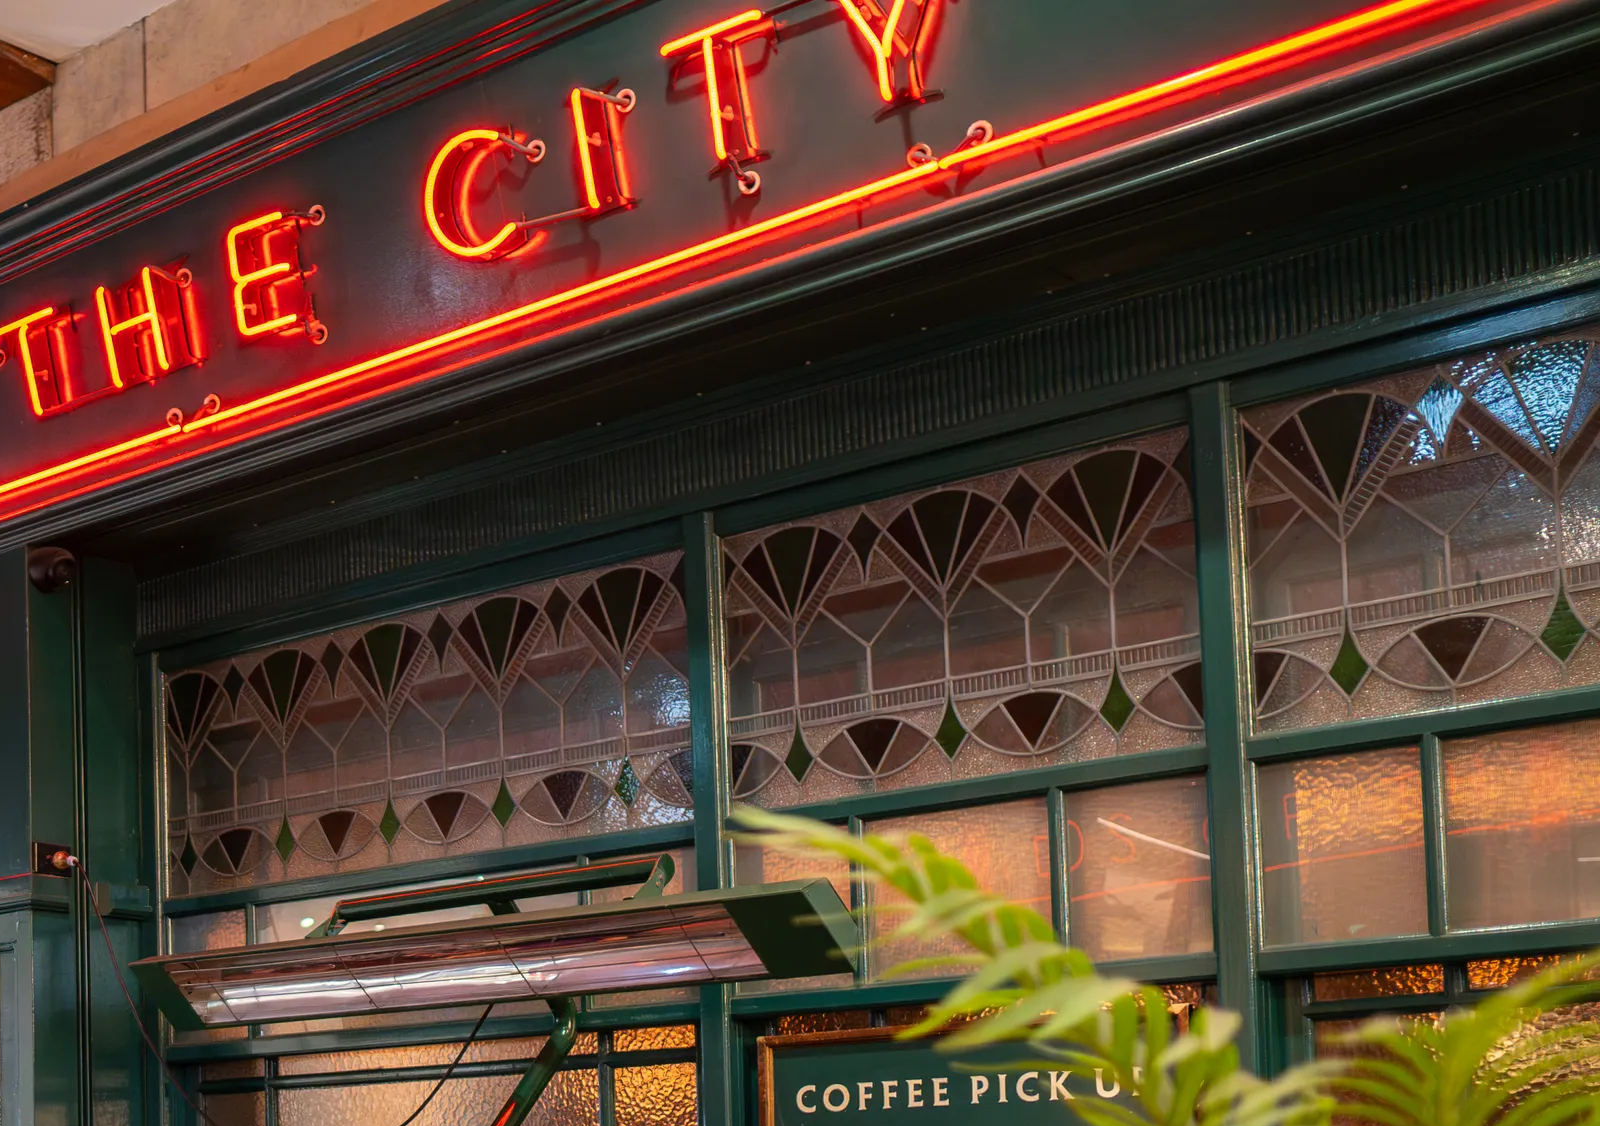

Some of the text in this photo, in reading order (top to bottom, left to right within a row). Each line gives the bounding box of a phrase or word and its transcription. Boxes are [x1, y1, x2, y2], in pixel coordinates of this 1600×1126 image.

[426, 0, 912, 257] CITY
[796, 1076, 951, 1114] COFFEE
[969, 1069, 1076, 1105] PICK
